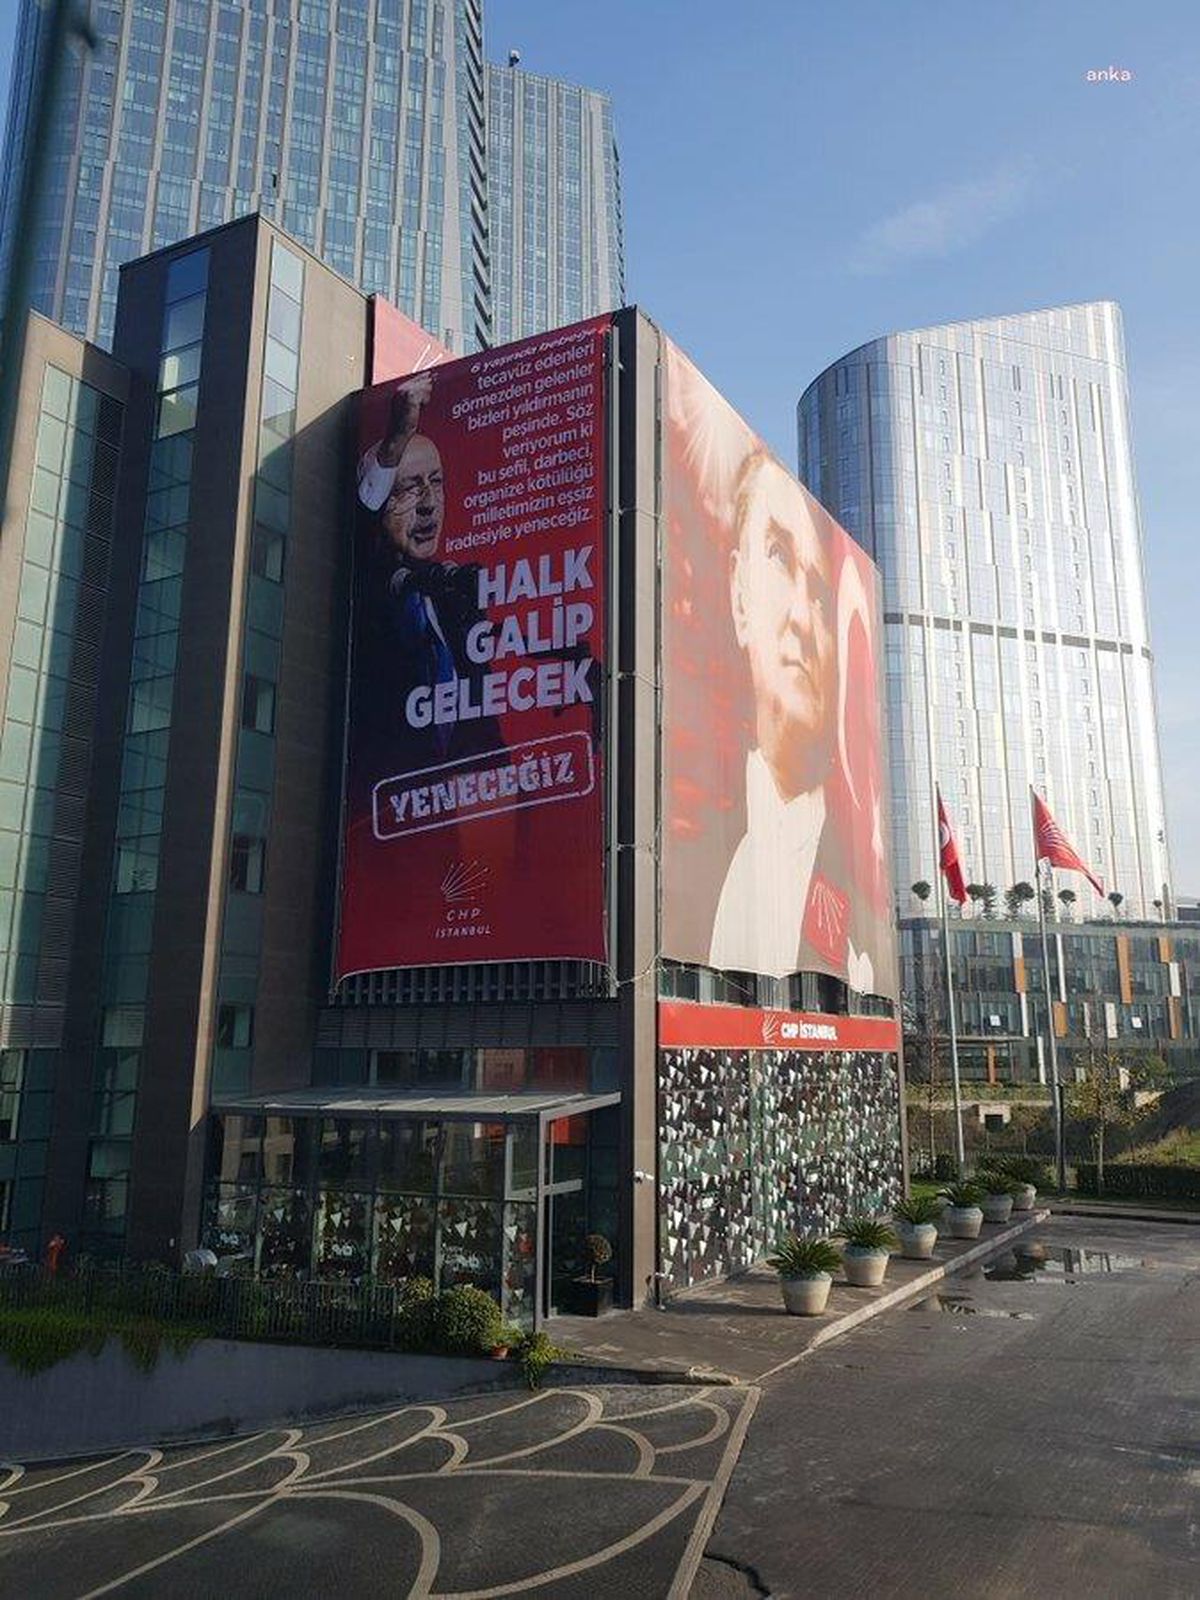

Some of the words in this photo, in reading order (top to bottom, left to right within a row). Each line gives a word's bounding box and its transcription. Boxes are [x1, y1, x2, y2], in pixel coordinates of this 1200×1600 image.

[477, 361, 533, 390] tecavüz
[535, 339, 595, 371] edenleri
[452, 382, 532, 419] görmezden
[534, 362, 595, 394] gelenler
[468, 404, 510, 431] bizleri
[512, 383, 593, 420] yıldırmanın
[502, 412, 562, 442] peşinde.
[566, 402, 594, 421] Söz
[503, 428, 577, 459] veriyorum
[580, 421, 593, 438] ki
[463, 482, 525, 510] organize
[527, 461, 594, 492] kötülüğü
[478, 470, 496, 486] bu
[499, 457, 531, 481] sefil,
[534, 442, 593, 470] darbeci,
[472, 493, 555, 527] milletimizin
[558, 484, 595, 506] eşsiz
[446, 523, 512, 553] iradesiyle
[477, 546, 594, 610] HALK
[466, 595, 594, 665] GALİP
[405, 657, 594, 728] GELECEK
[390, 751, 576, 823] YENECEĞİZ
[446, 907, 481, 922] CHP
